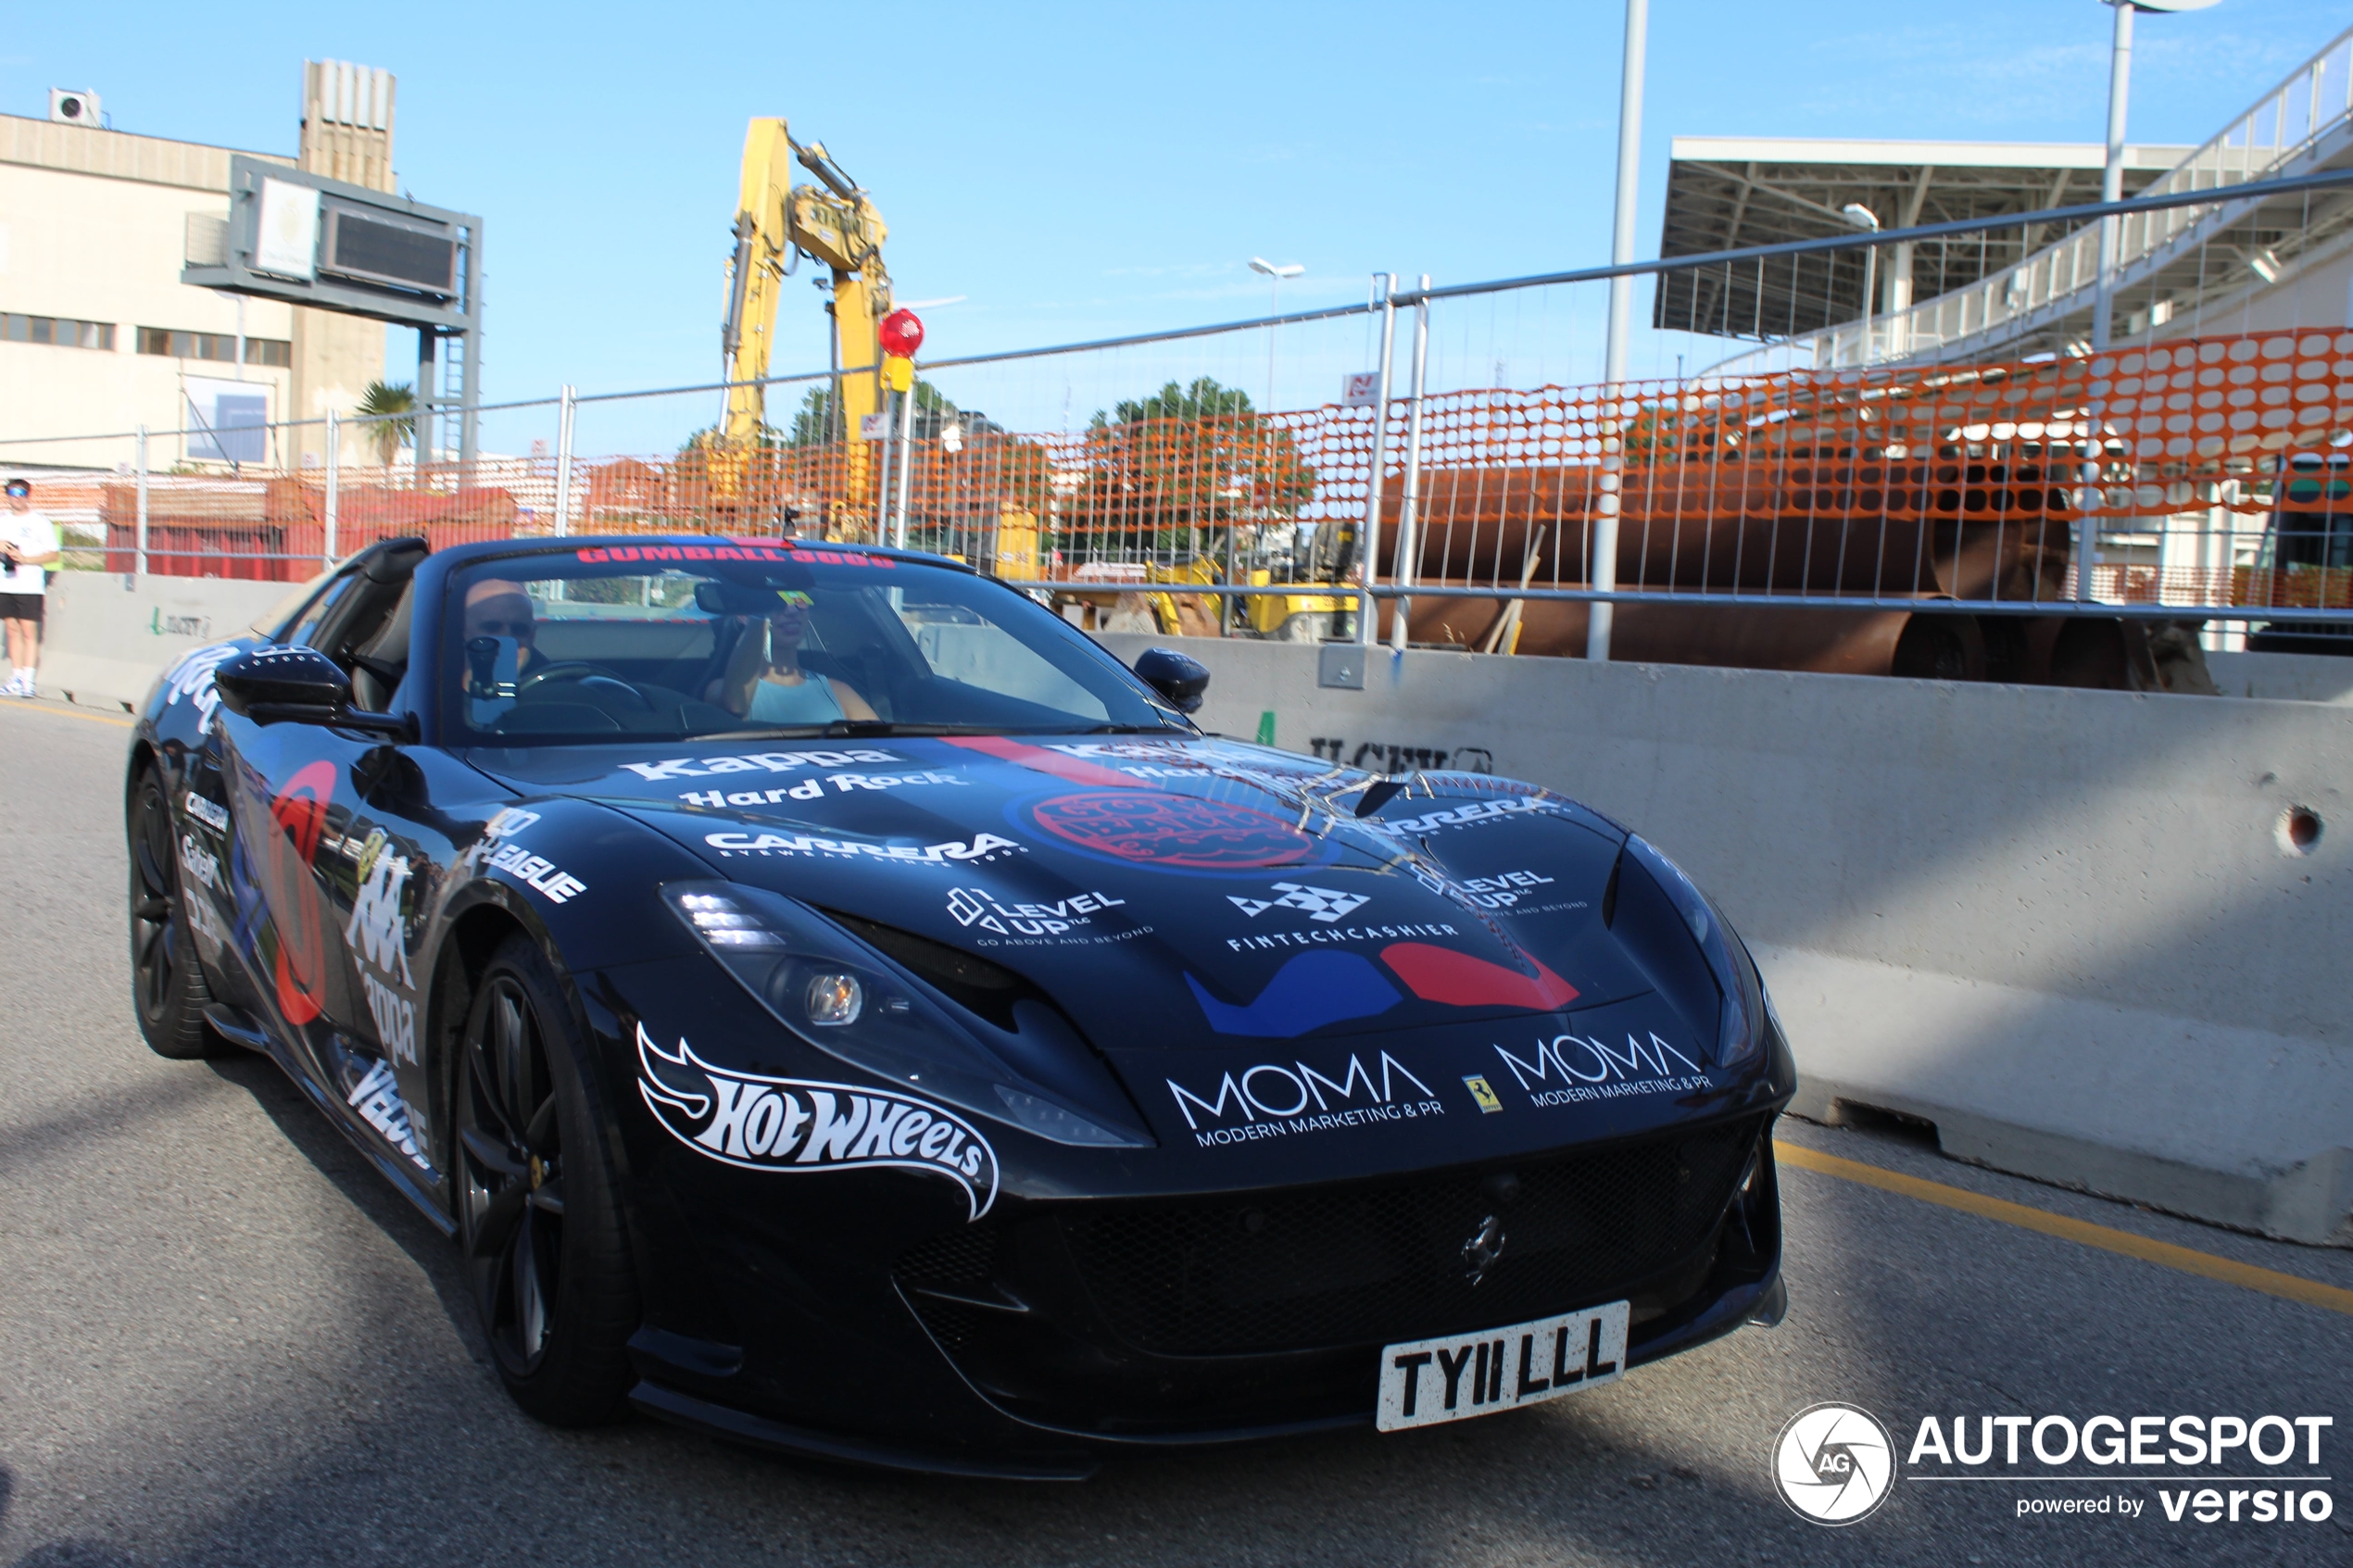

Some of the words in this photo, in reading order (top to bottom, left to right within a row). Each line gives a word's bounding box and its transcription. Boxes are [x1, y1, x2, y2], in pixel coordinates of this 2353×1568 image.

[576, 546, 786, 564] GUMBALL
[791, 550, 897, 569] 3000
[618, 750, 908, 782] Kappa
[679, 778, 825, 809] Hard
[826, 771, 970, 793] Rock
[705, 833, 1021, 862] CARRERA
[719, 850, 854, 860] EYEWEAR
[480, 842, 588, 905] LEAGUE
[1448, 870, 1556, 895] LEVEL
[990, 891, 1126, 919] LEVEL
[1469, 891, 1519, 909] UP
[976, 938, 1000, 947] GO
[1005, 937, 1055, 947] ABOVE
[1059, 937, 1090, 946] AND
[1094, 926, 1154, 945] BEYOND
[1009, 919, 1071, 936] UP
[1227, 923, 1460, 952] FINTECHCASHIER
[1492, 1030, 1702, 1091] MOMA
[1165, 1049, 1435, 1130] MOMA
[1529, 1085, 1601, 1109] MODERN
[1599, 1076, 1682, 1099] MARKETING
[1682, 1077, 1694, 1090] &
[1692, 1074, 1714, 1089] PR
[1195, 1121, 1287, 1148] MODERN
[1289, 1104, 1402, 1134] MARKETING
[1403, 1102, 1418, 1118] &
[1418, 1100, 1445, 1116] PR
[1517, 1318, 1617, 1399] LLL
